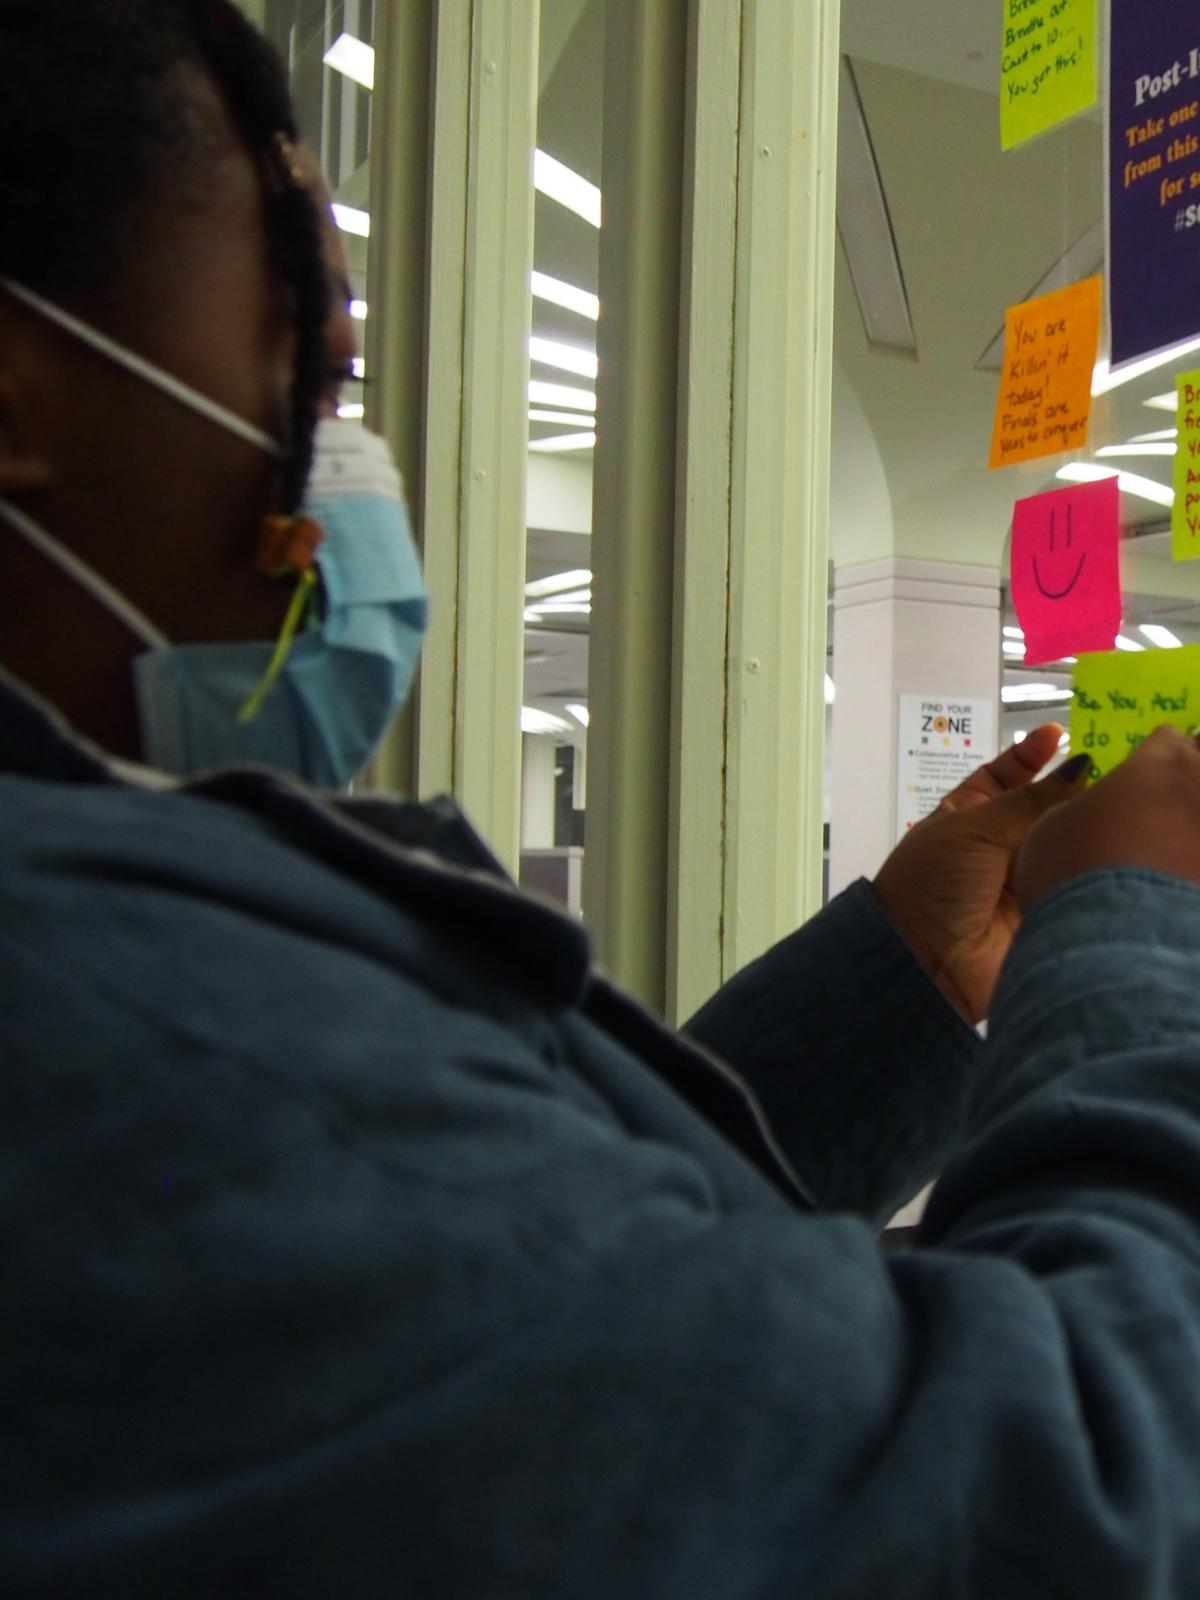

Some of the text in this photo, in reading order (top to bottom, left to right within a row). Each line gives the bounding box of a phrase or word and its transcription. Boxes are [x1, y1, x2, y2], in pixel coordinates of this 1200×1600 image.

[1002, 48, 1028, 73] Count
[1008, 80, 1028, 104] You
[1031, 66, 1050, 94] got
[1126, 118, 1164, 147] Take
[1169, 101, 1198, 127] one
[1125, 155, 1162, 187] from
[1167, 134, 1198, 163] this
[1160, 178, 1184, 207] for
[1013, 318, 1067, 352] You are
[1057, 343, 1070, 366] it
[1005, 373, 1051, 408] today!
[1002, 402, 1069, 432] Finals are
[1043, 416, 1088, 445] conquer
[921, 703, 972, 714] FIND YOUR
[1151, 687, 1189, 711] And
[921, 715, 972, 734] ZONE
[1083, 719, 1110, 748] do
